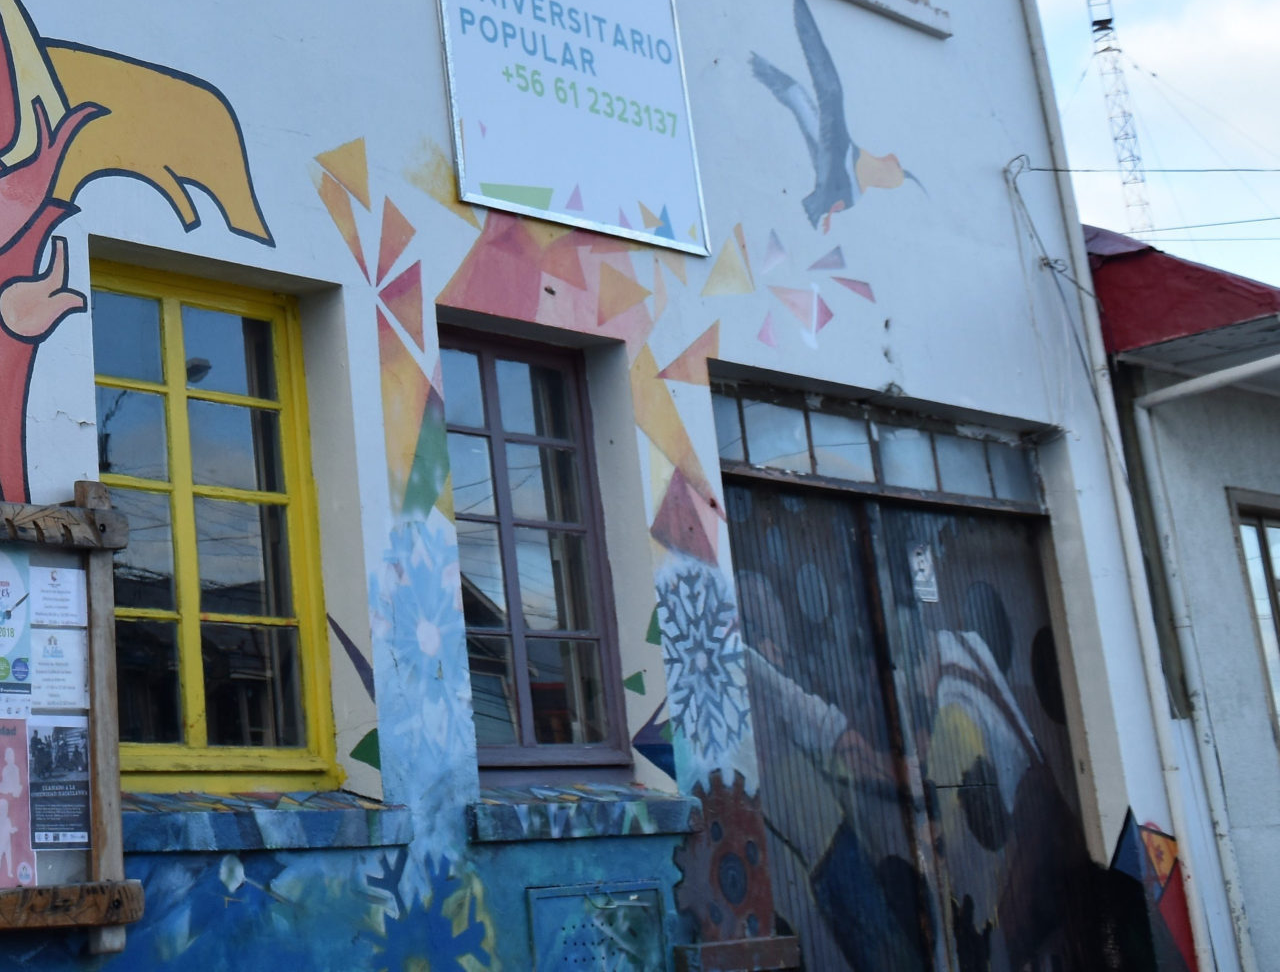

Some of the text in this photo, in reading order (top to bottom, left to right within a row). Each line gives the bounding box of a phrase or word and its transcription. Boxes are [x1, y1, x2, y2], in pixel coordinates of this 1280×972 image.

[459, 7, 597, 77] POPULAR
[501, 63, 678, 138] +56 61 2323137
